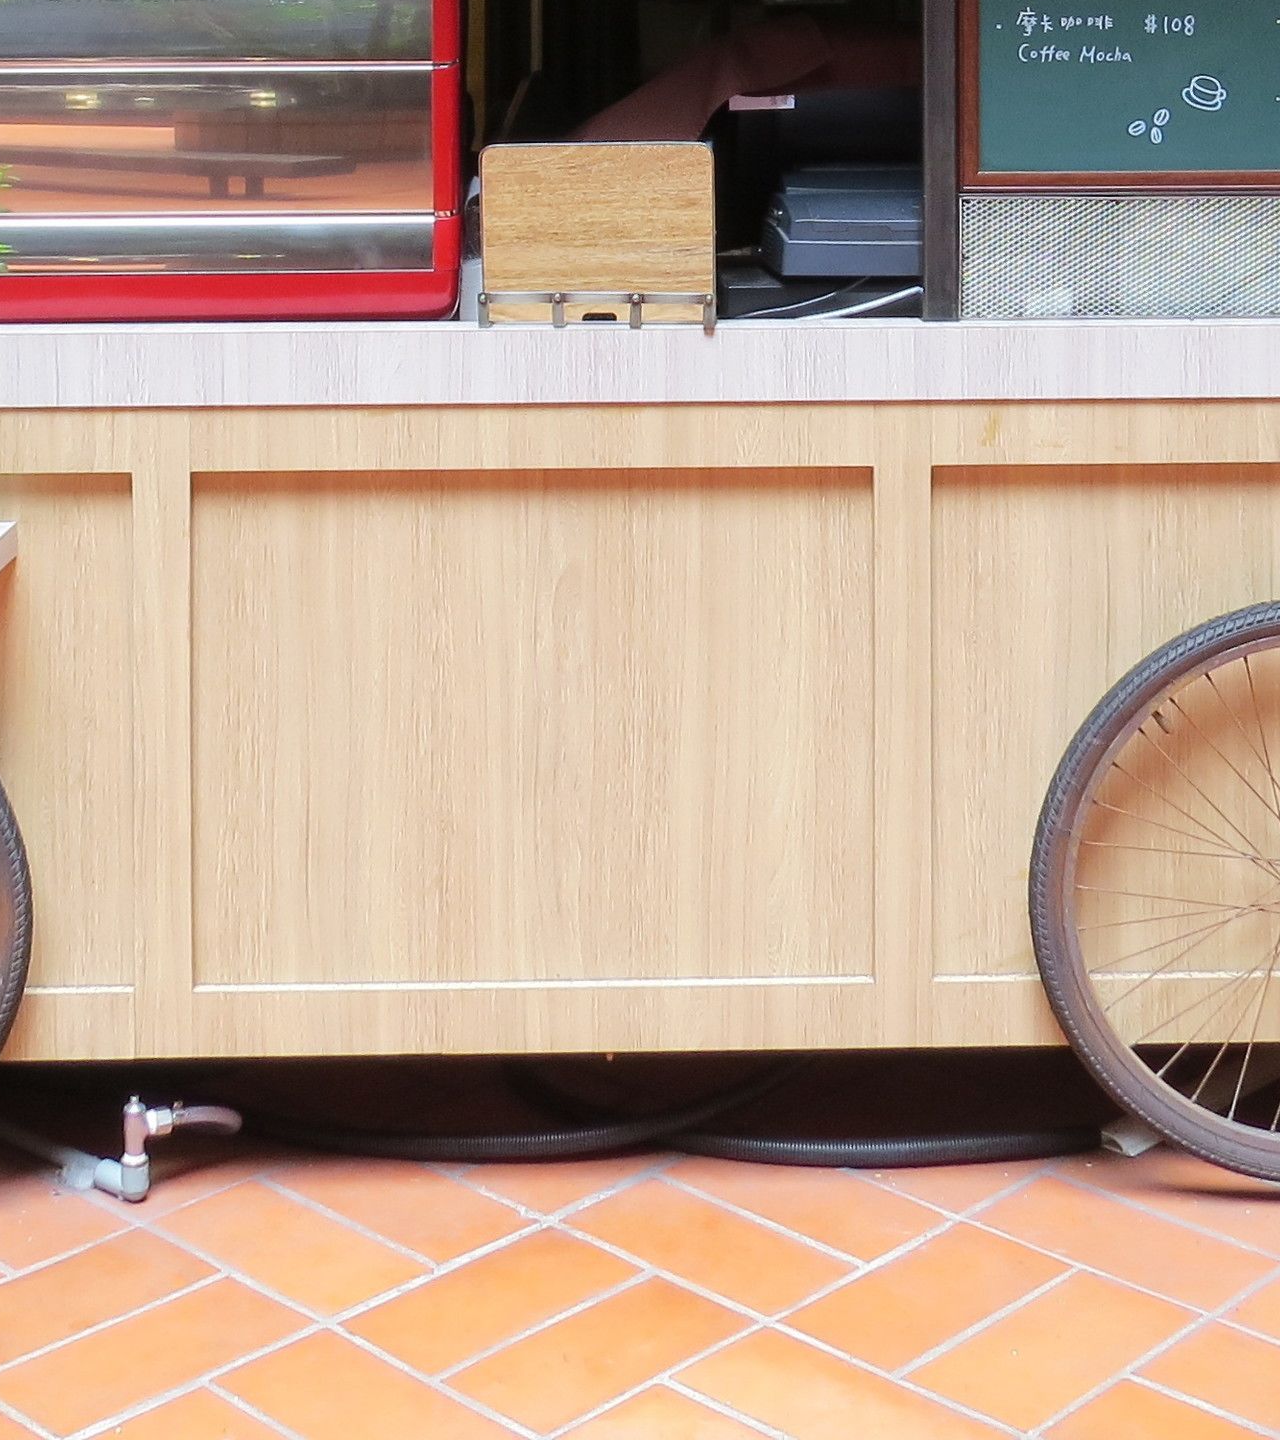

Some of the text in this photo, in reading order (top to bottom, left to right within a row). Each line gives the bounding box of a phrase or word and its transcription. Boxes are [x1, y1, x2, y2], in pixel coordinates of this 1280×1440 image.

[1017, 7, 1195, 36] 摩卡咖啡 $108
[1019, 44, 1133, 63] Coffee Mocha
